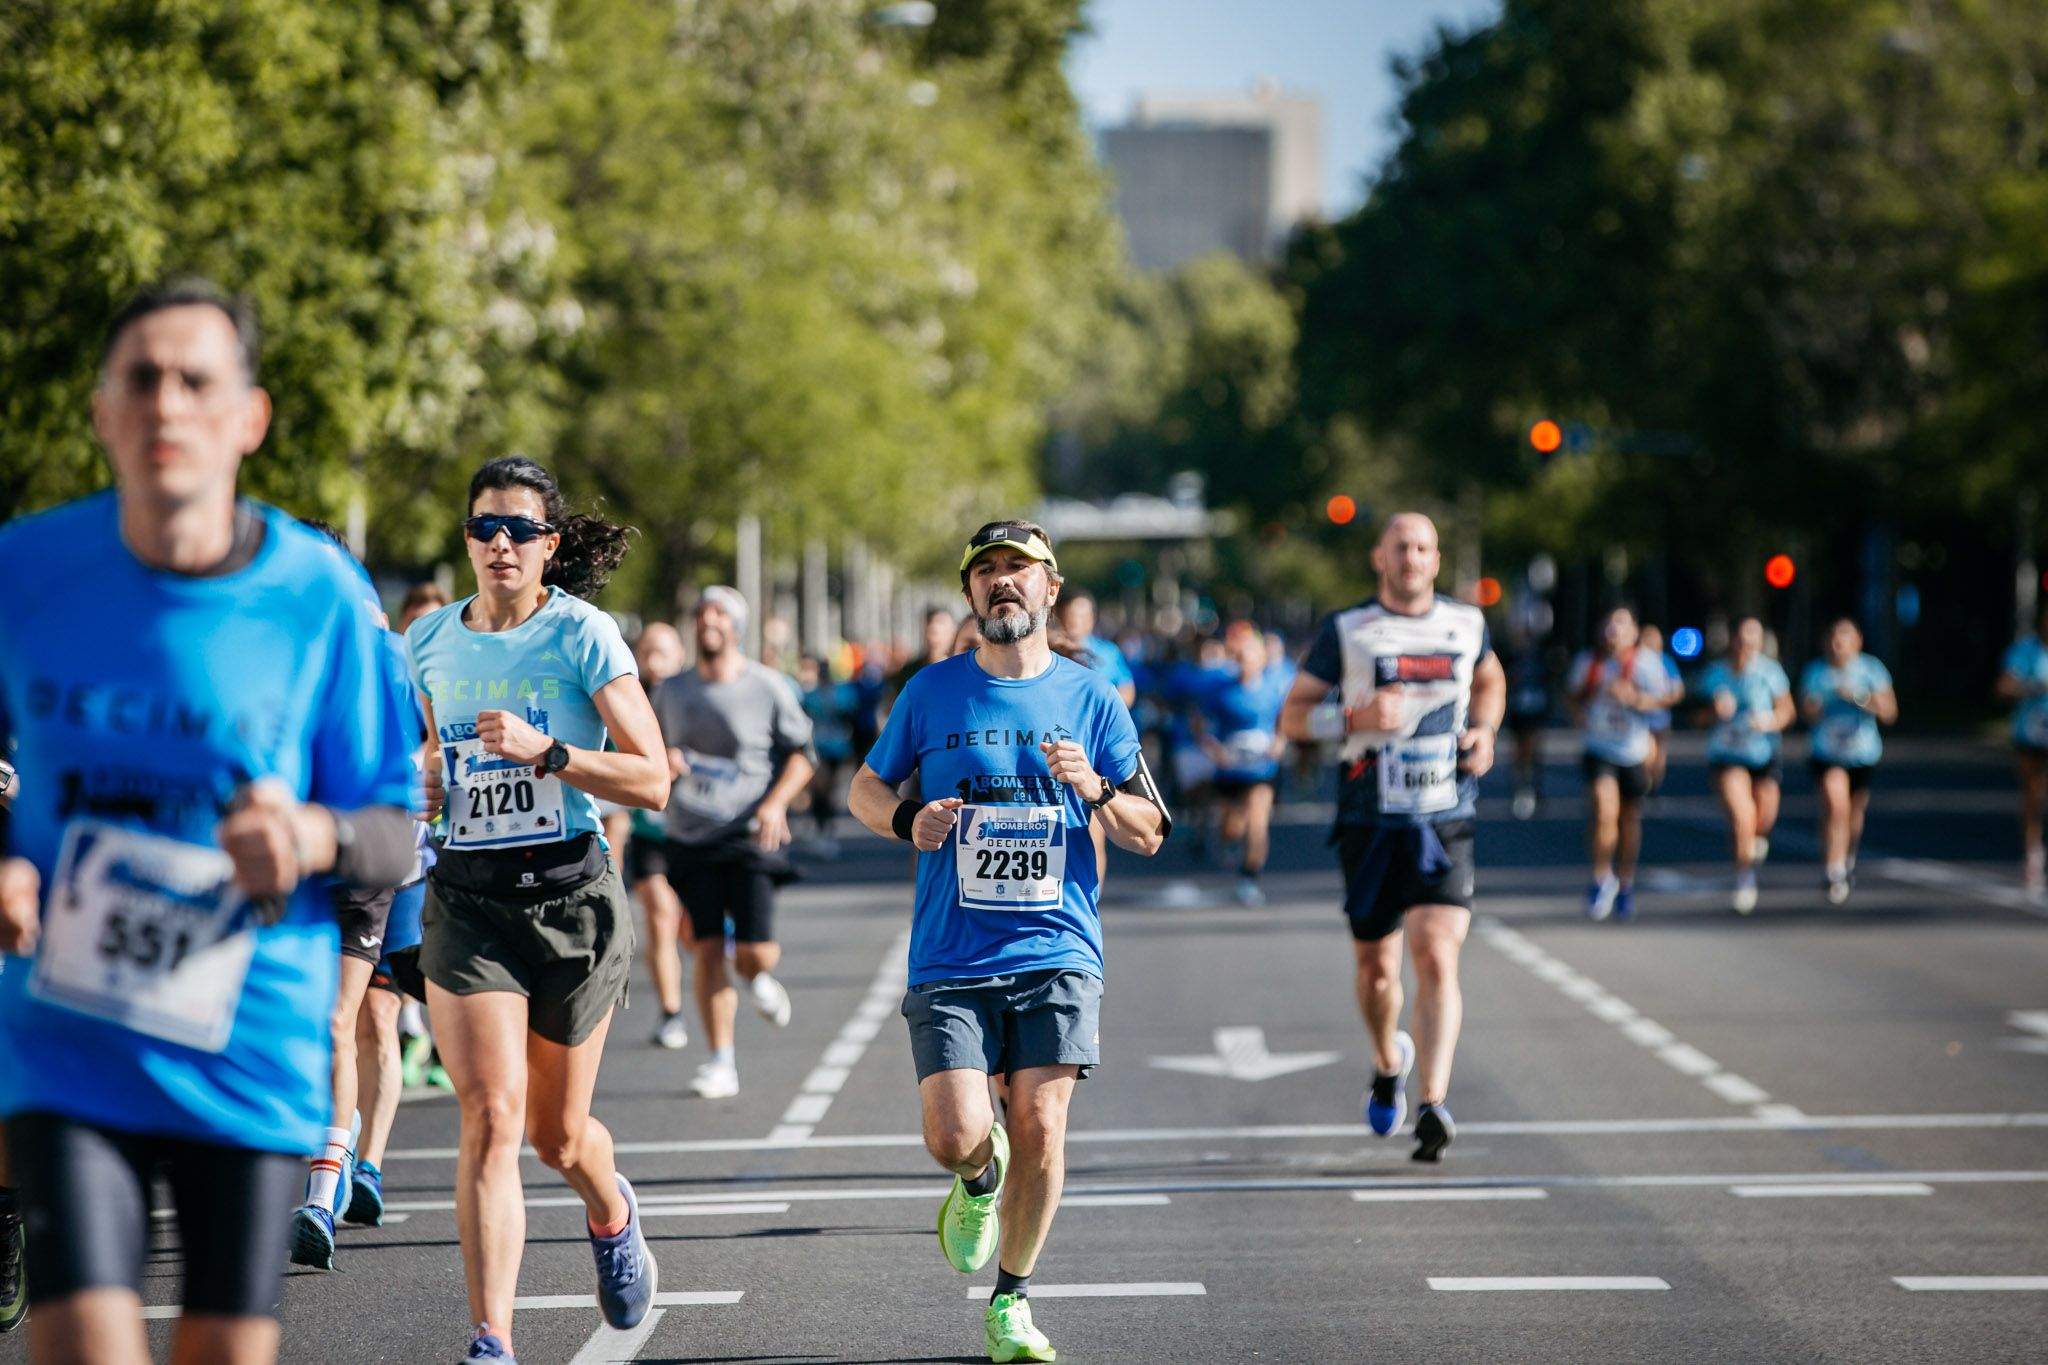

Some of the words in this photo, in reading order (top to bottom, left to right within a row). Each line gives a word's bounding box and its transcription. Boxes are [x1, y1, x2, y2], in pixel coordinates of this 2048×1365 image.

[473, 768, 532, 783] DECIMAS
[468, 780, 535, 819] 2120
[994, 822, 1047, 830] BOMBEROS
[987, 839, 1046, 847] DECIMAS
[976, 849, 1048, 881] 2239
